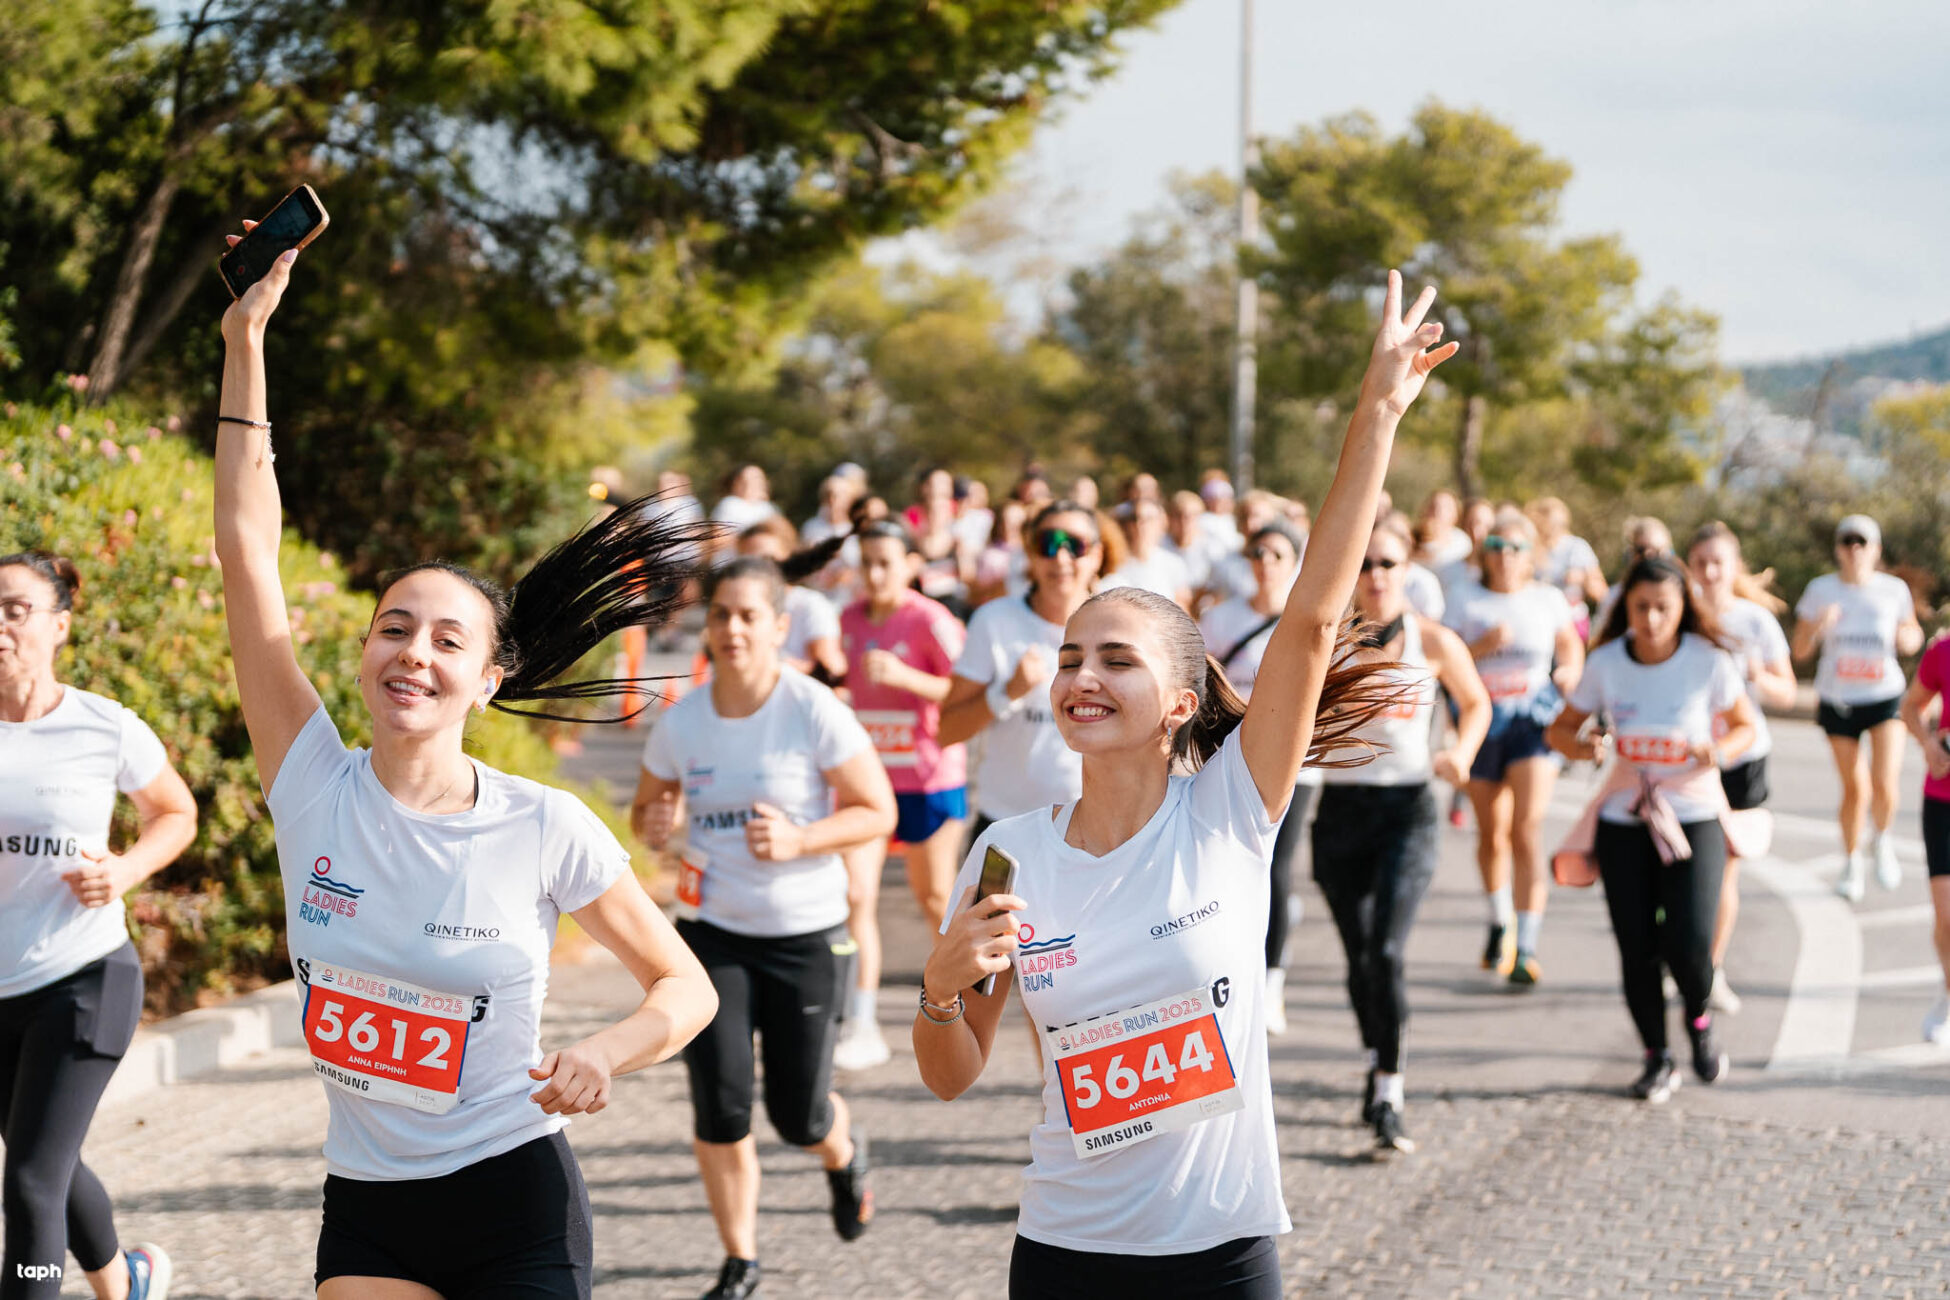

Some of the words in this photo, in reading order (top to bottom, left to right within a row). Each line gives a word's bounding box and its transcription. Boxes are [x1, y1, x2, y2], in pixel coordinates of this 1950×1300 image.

[0, 834, 77, 857] SUNG
[299, 902, 331, 927] RUN
[302, 885, 358, 918] LADIES
[424, 922, 500, 938] QINETIKO
[1150, 900, 1219, 936] QINETIKO
[1020, 949, 1078, 976] LADIES
[337, 972, 387, 998] LADIES
[387, 985, 420, 1006] RUN
[421, 994, 463, 1014] 2025
[1023, 972, 1053, 993] RUN
[314, 1000, 452, 1071] 5612
[1071, 1021, 1123, 1049] LADIES
[1123, 1010, 1158, 1033] RUN
[1158, 997, 1202, 1023] 2025
[314, 1061, 370, 1092] SAMSUNG
[1072, 1030, 1215, 1110] 5644
[1085, 1120, 1154, 1151] SAMSUNG
